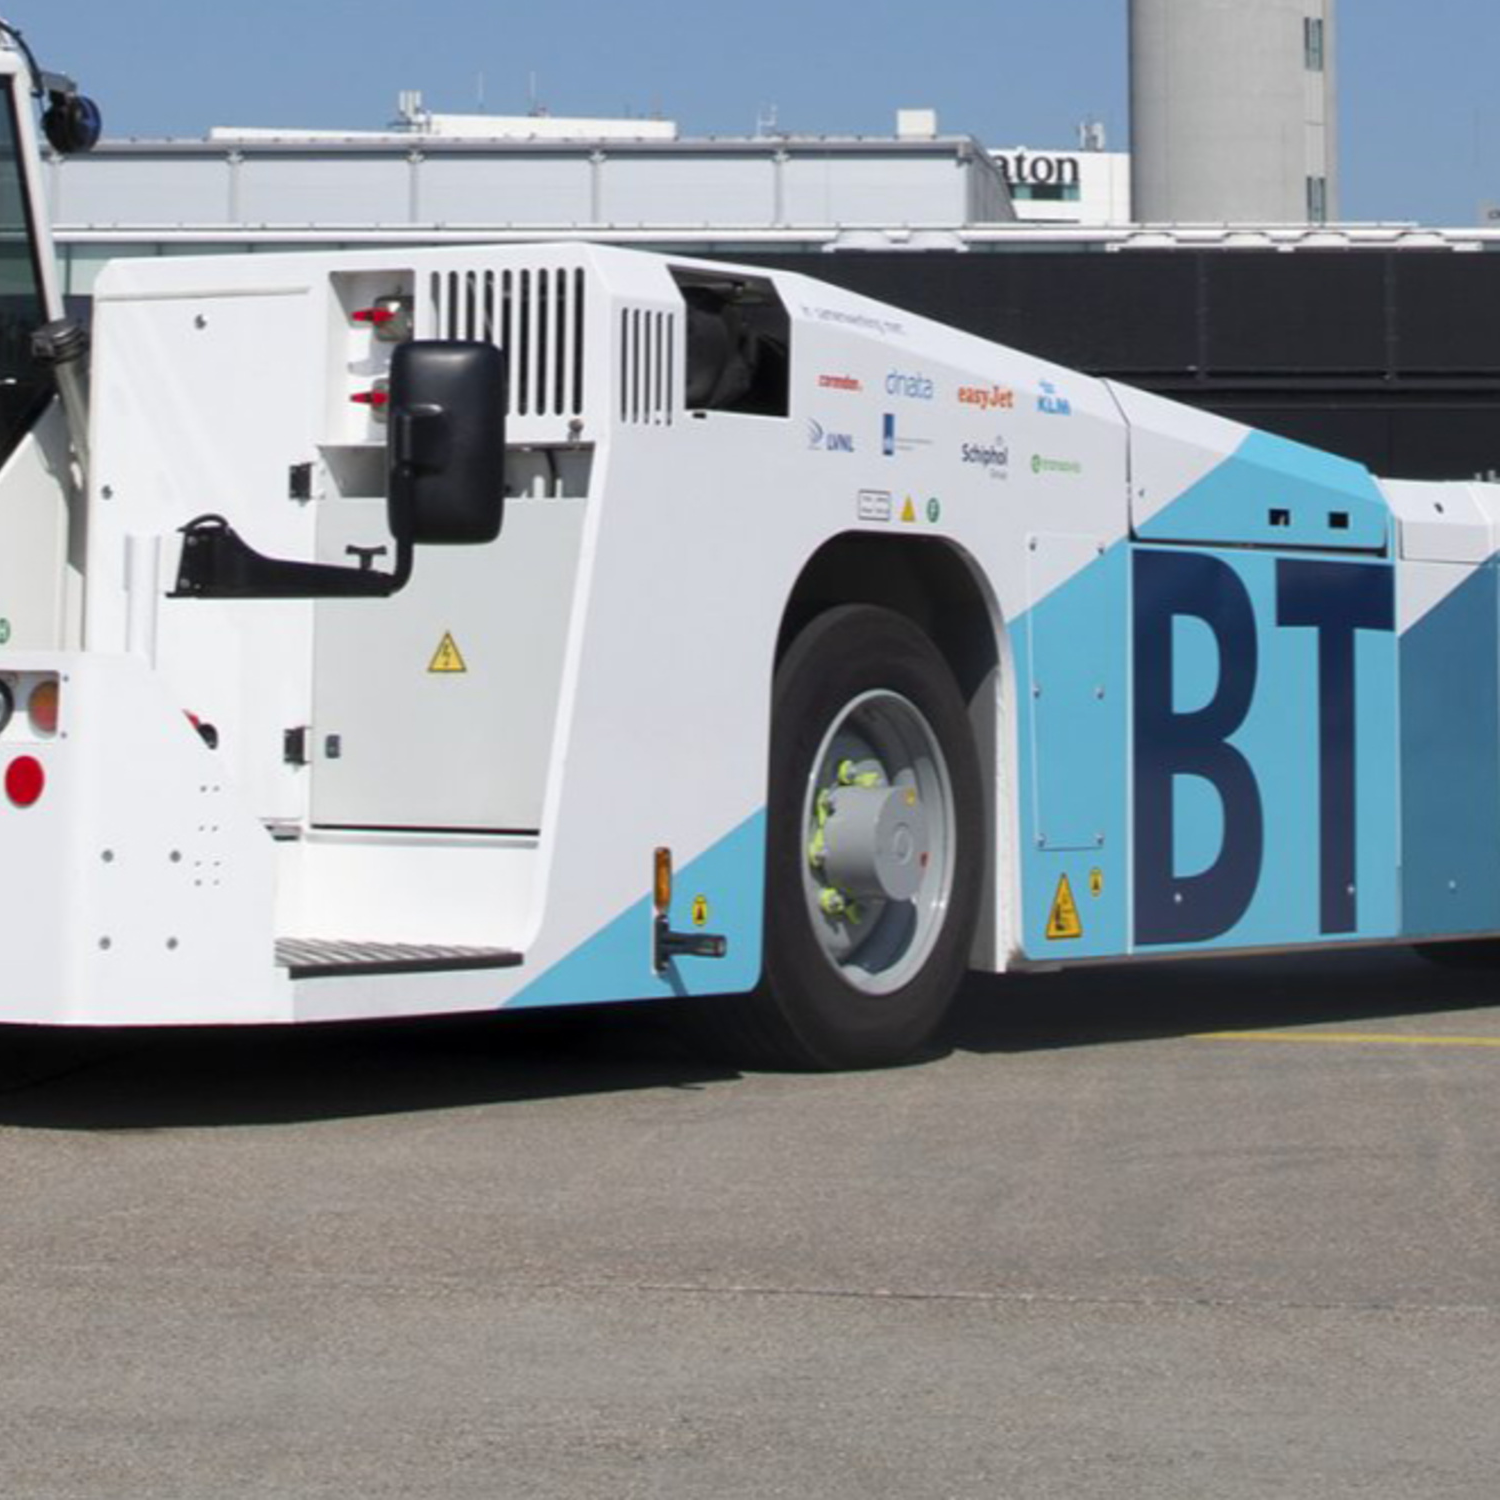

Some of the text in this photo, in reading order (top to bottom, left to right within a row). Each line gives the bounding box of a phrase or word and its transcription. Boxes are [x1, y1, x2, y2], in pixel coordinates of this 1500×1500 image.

[886, 368, 933, 400] dnata
[958, 385, 1013, 410] easyJet
[1037, 396, 1071, 416] KLM
[961, 442, 1008, 467] Schiphol
[1132, 548, 1395, 946] BT
